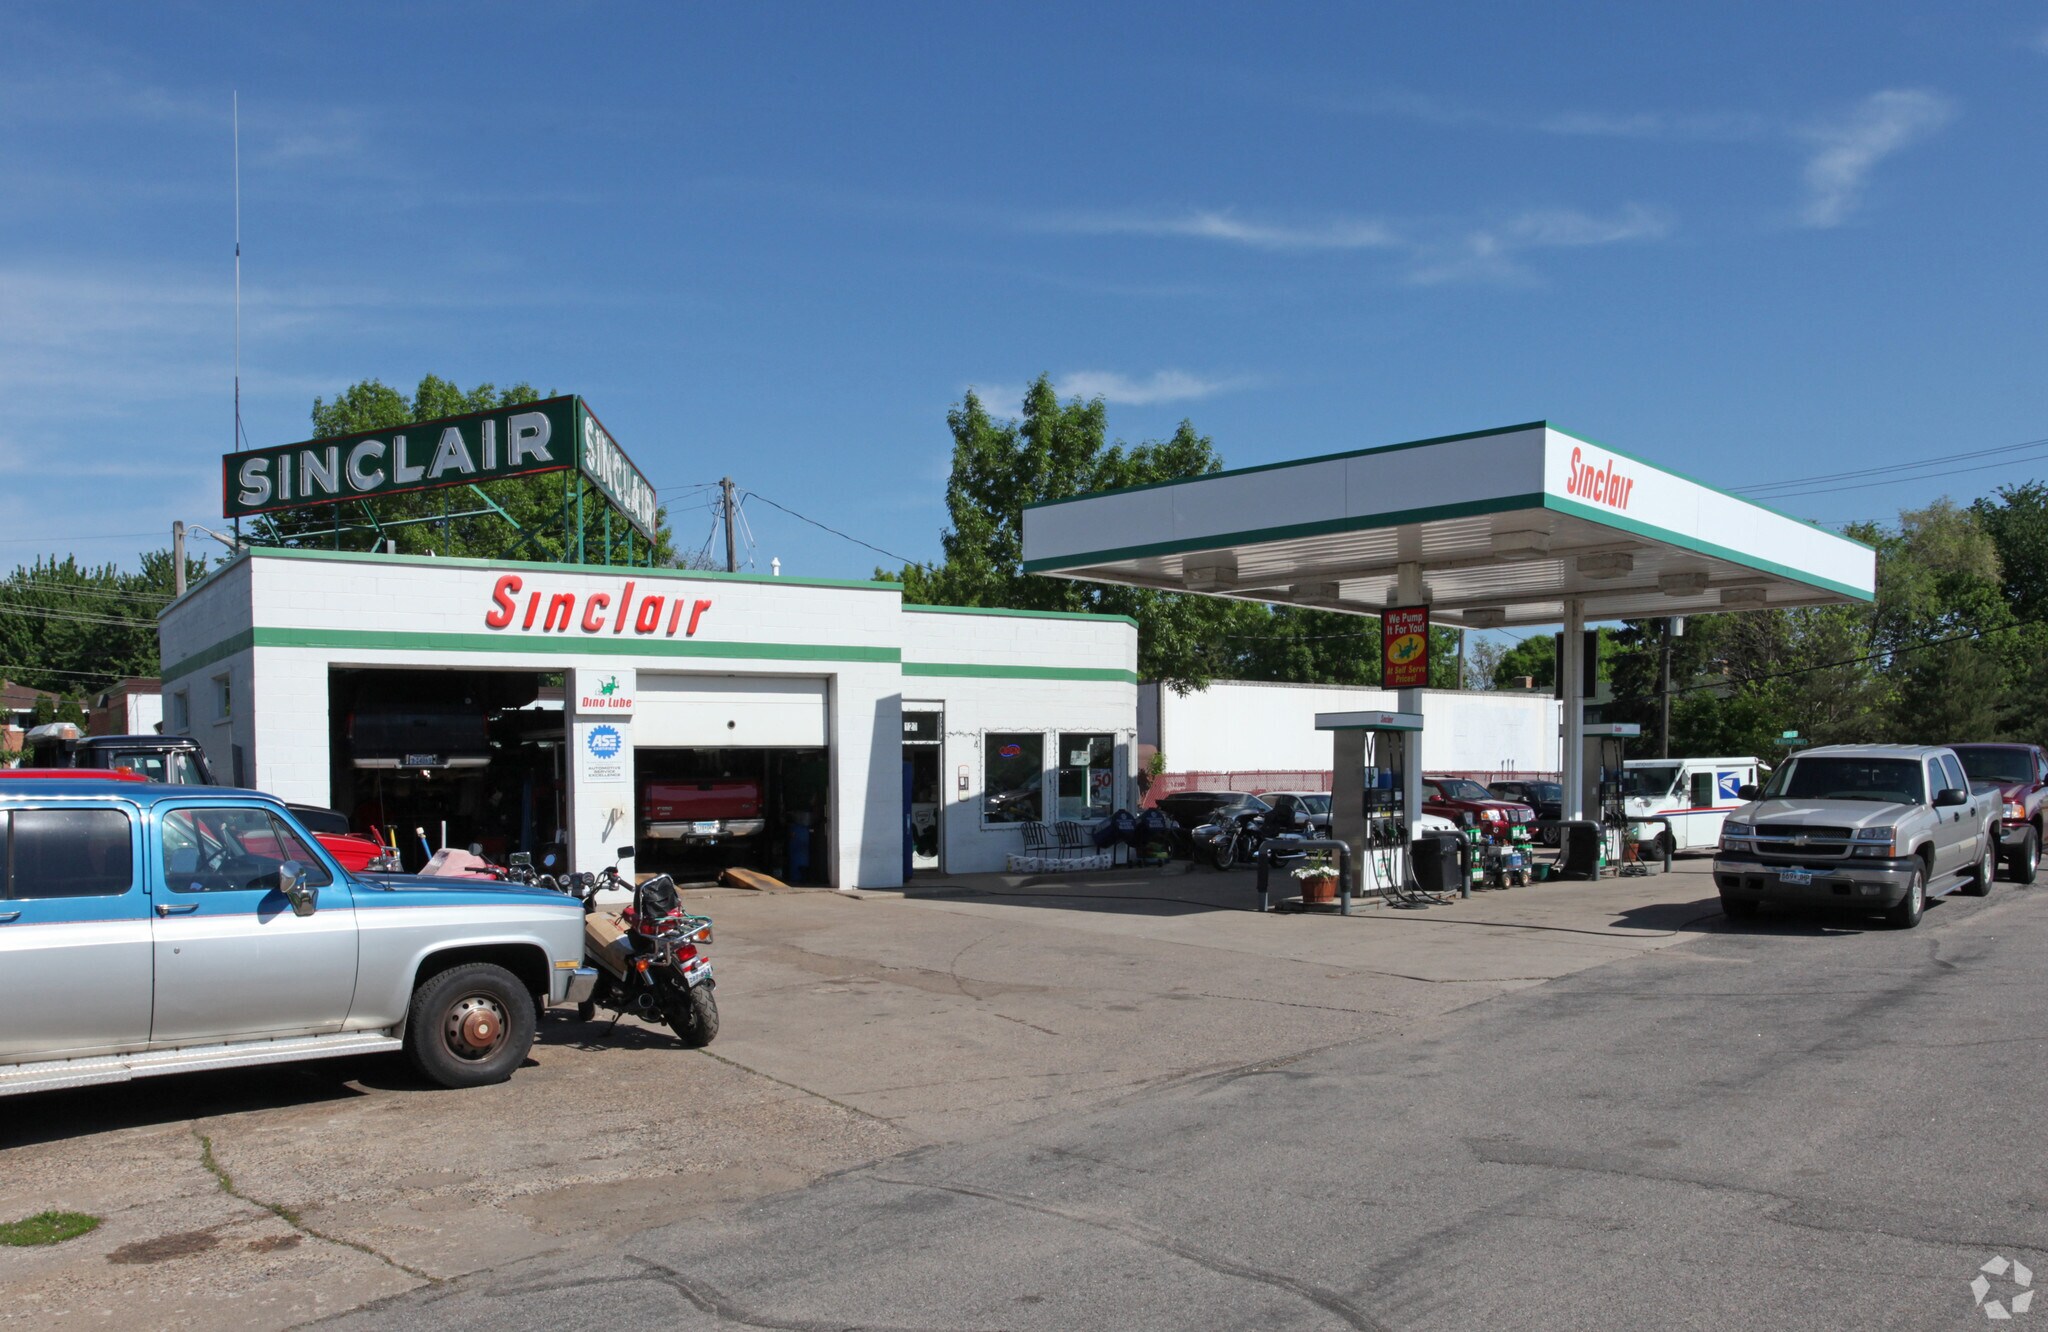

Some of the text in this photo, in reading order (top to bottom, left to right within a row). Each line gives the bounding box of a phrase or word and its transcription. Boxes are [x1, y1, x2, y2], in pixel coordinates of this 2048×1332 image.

[238, 411, 555, 506] SINCLAIR
[584, 416, 656, 534] SINCLAIR
[1567, 446, 1634, 510] Sinclair
[486, 574, 712, 637] Sinclair
[1388, 613, 1423, 624] We Pump
[1387, 622, 1425, 635] It For You!
[1408, 665, 1426, 673] Serve
[582, 696, 632, 708] Dino Lube
[591, 734, 617, 748] ASE
